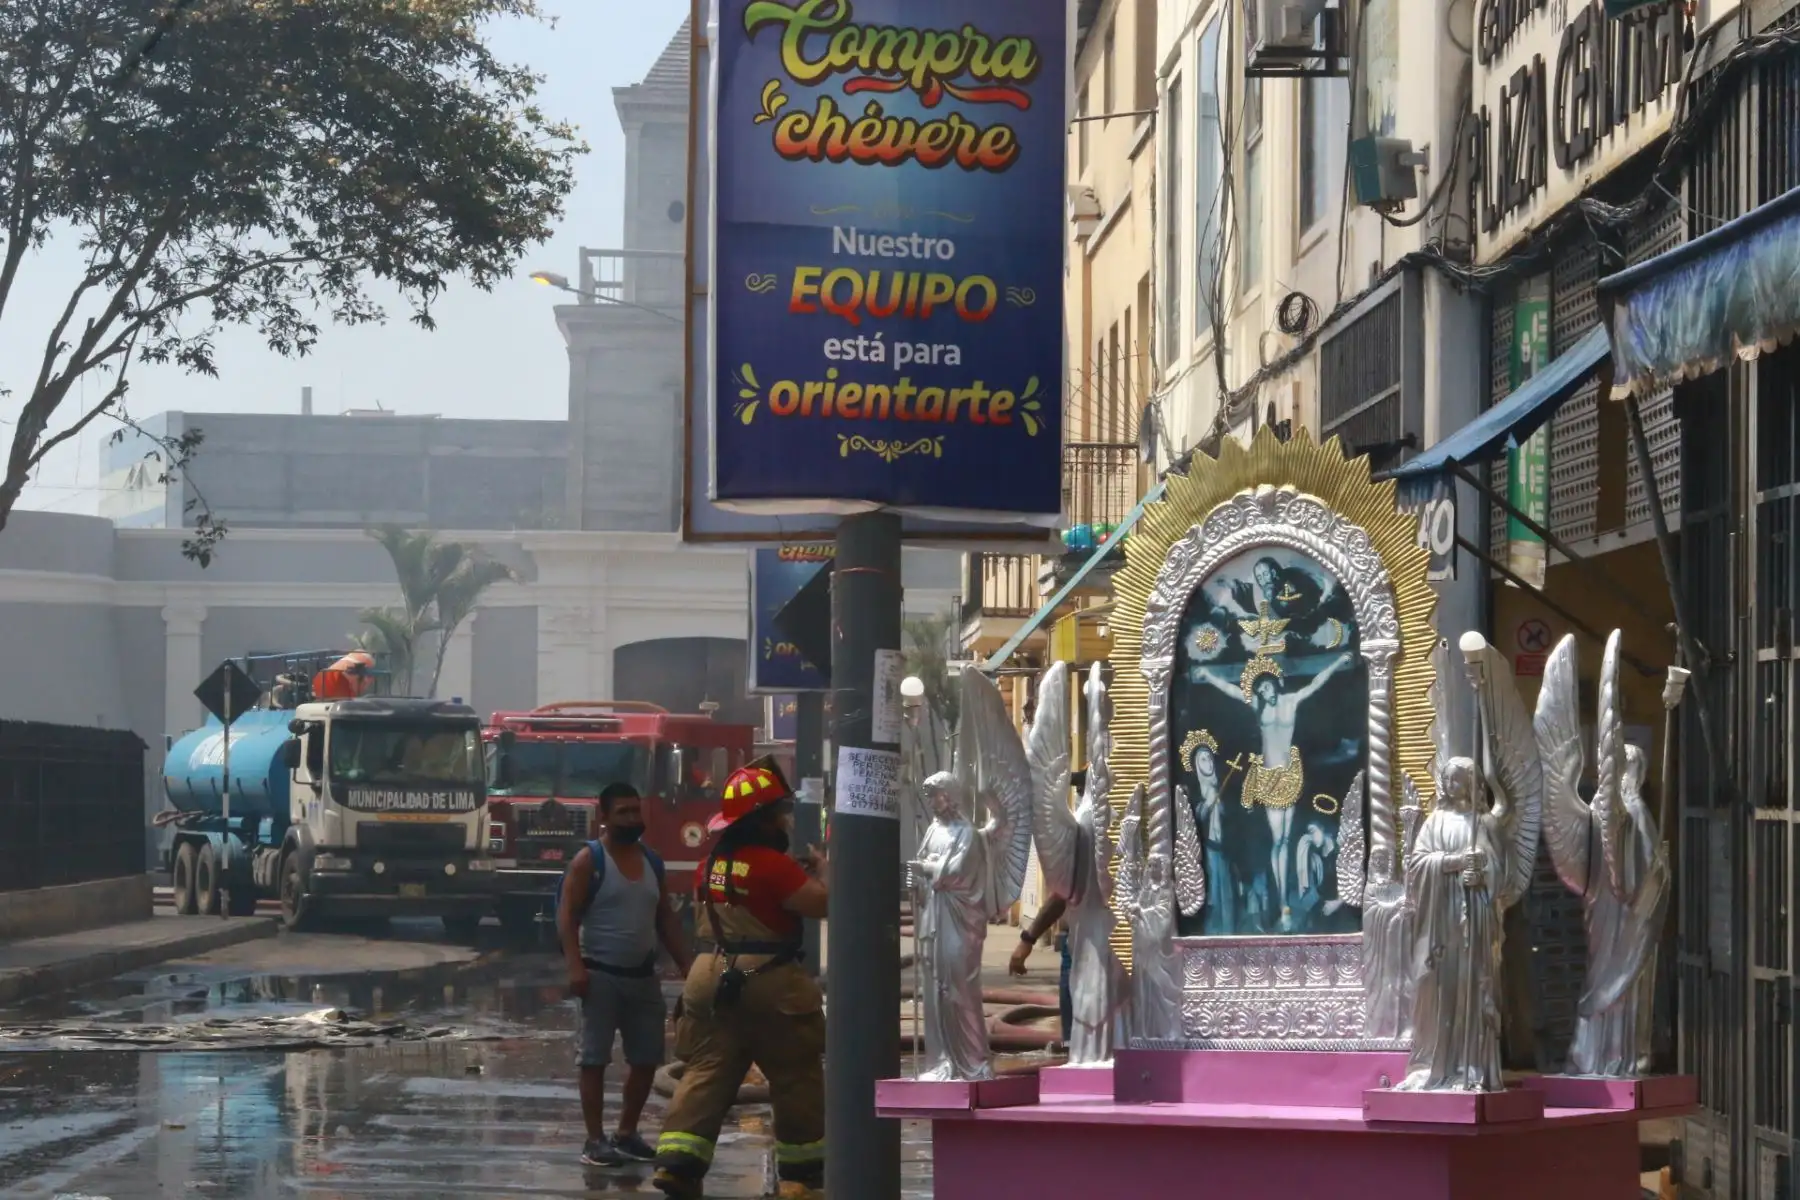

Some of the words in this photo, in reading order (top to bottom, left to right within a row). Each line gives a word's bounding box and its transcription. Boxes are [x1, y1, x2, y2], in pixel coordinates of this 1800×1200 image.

[744, 0, 1041, 91] Compra
[773, 97, 1020, 171] chévere
[832, 226, 955, 260] Nuestro
[787, 266, 998, 327] EQUIPO
[823, 332, 886, 362] está
[893, 340, 961, 370] para
[768, 367, 1016, 425] orientarte
[348, 790, 429, 809] MUNICIPALIDAD
[432, 791, 447, 809] DE
[448, 791, 476, 810] LIMA
